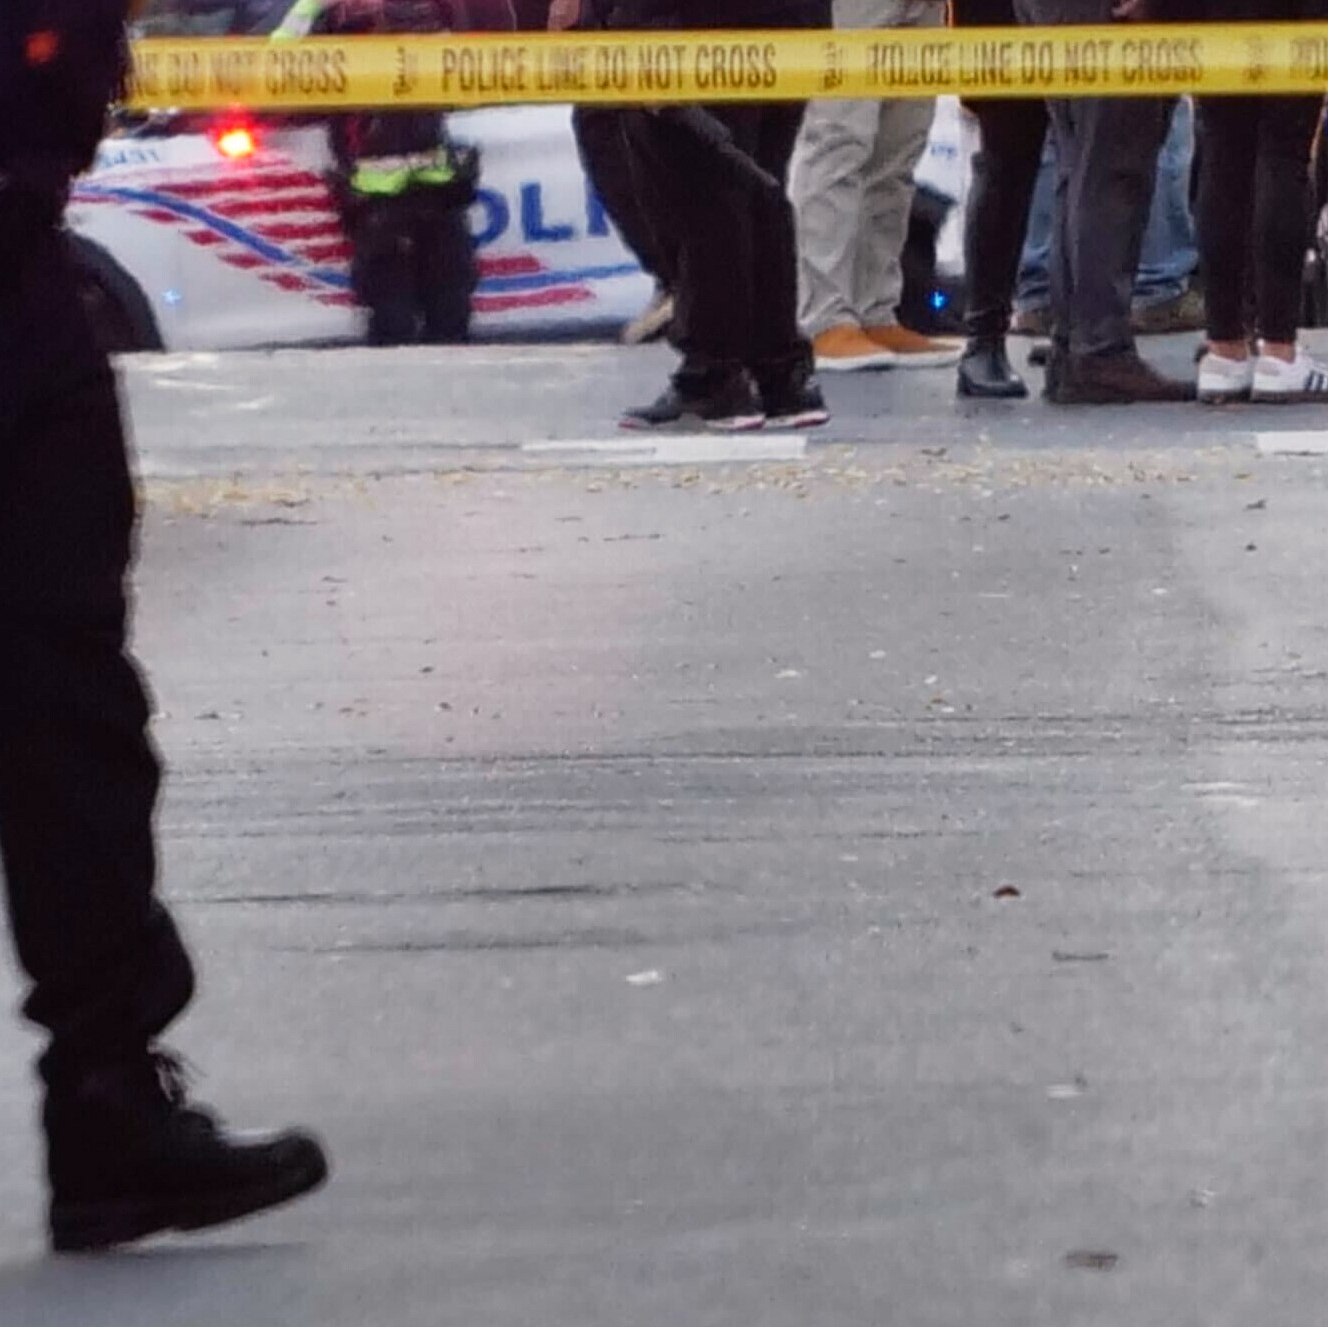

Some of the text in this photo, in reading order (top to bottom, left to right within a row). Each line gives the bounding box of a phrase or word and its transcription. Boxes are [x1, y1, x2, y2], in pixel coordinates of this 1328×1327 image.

[264, 48, 347, 94] CROSS
[441, 46, 526, 91] POLICE
[537, 46, 587, 91] LINE
[595, 45, 628, 90] DO
[637, 44, 687, 89] NOT
[694, 43, 777, 88] CROSS
[867, 42, 951, 85] POLICE
[960, 41, 1012, 84] LINE
[1021, 40, 1053, 83] DO
[1062, 39, 1113, 83] NOT
[1121, 38, 1204, 82] CROSS
